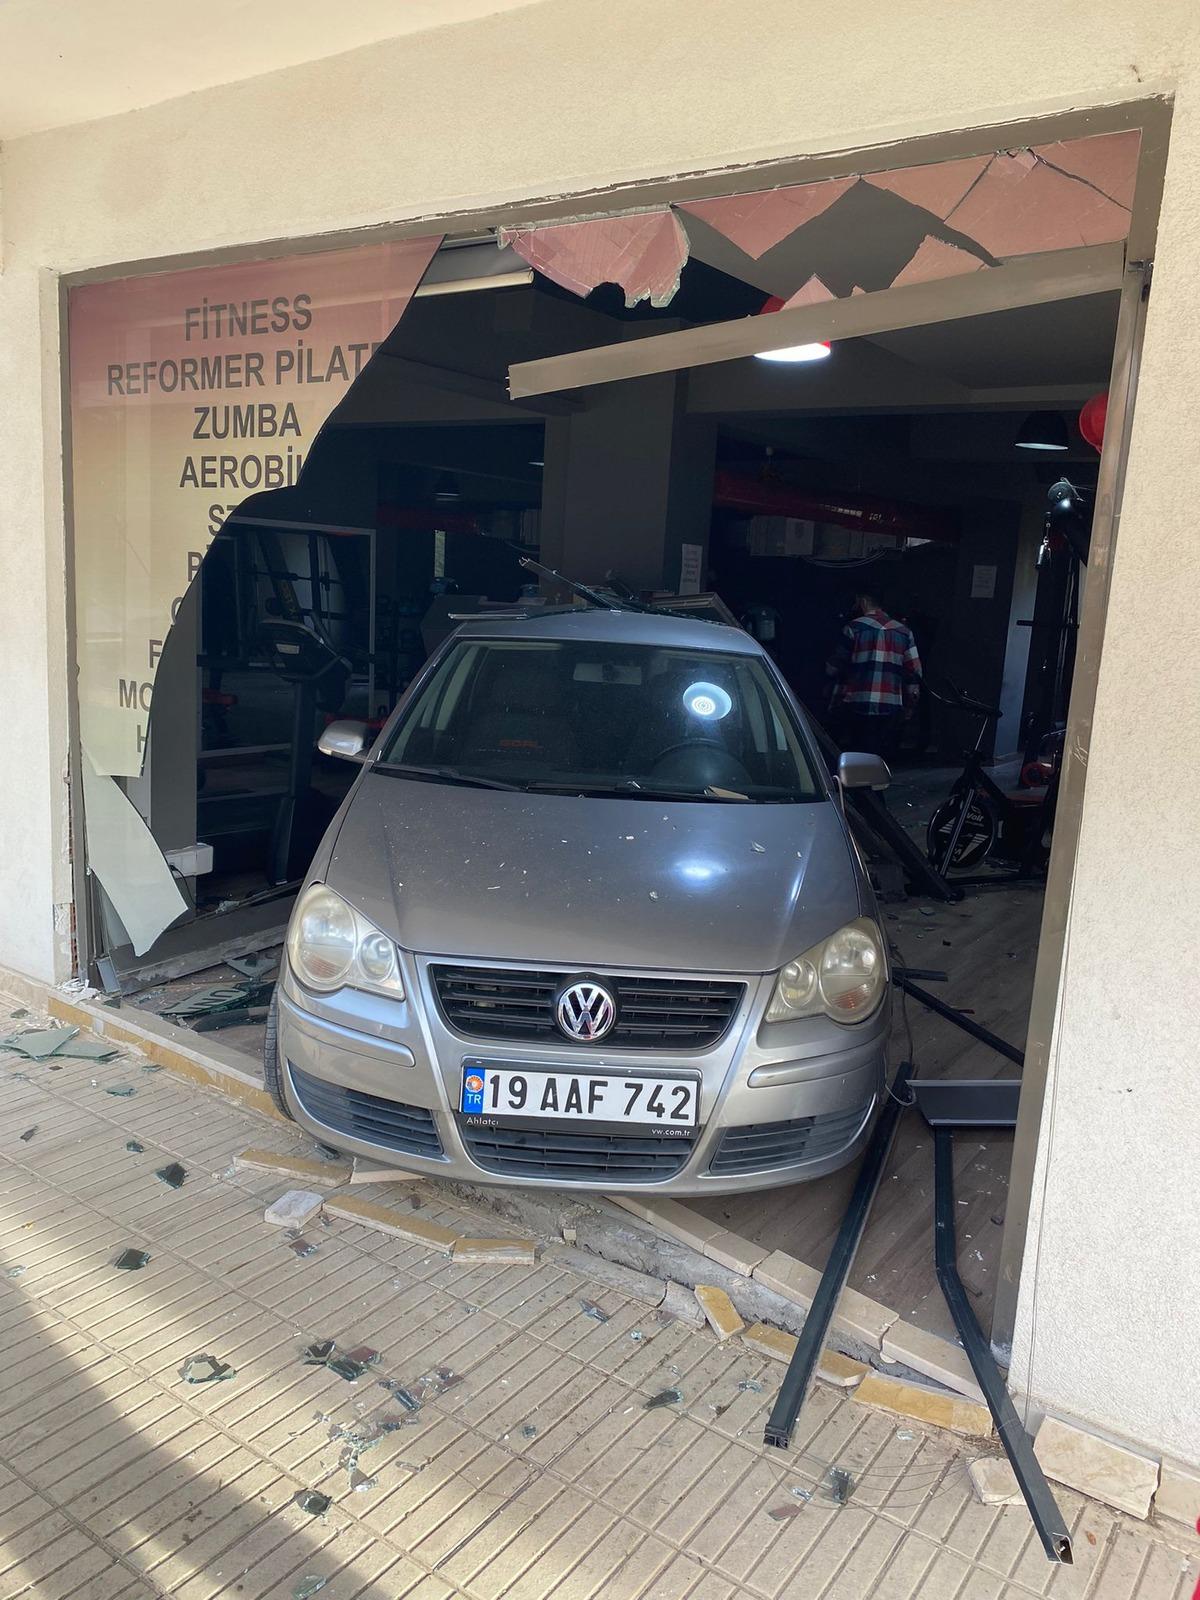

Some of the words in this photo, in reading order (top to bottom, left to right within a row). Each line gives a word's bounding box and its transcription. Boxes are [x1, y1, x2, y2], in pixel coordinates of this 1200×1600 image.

[185, 294, 312, 341] FİTNESS
[107, 352, 266, 396] REFORMER
[275, 339, 384, 385] PİLAT
[193, 402, 302, 439] ZUMBA
[467, 1093, 482, 1105] TR
[490, 1074, 528, 1110] 19
[540, 1077, 608, 1114] AAF
[624, 1082, 691, 1120] 742
[651, 1127, 691, 1136] vw.com.tr
